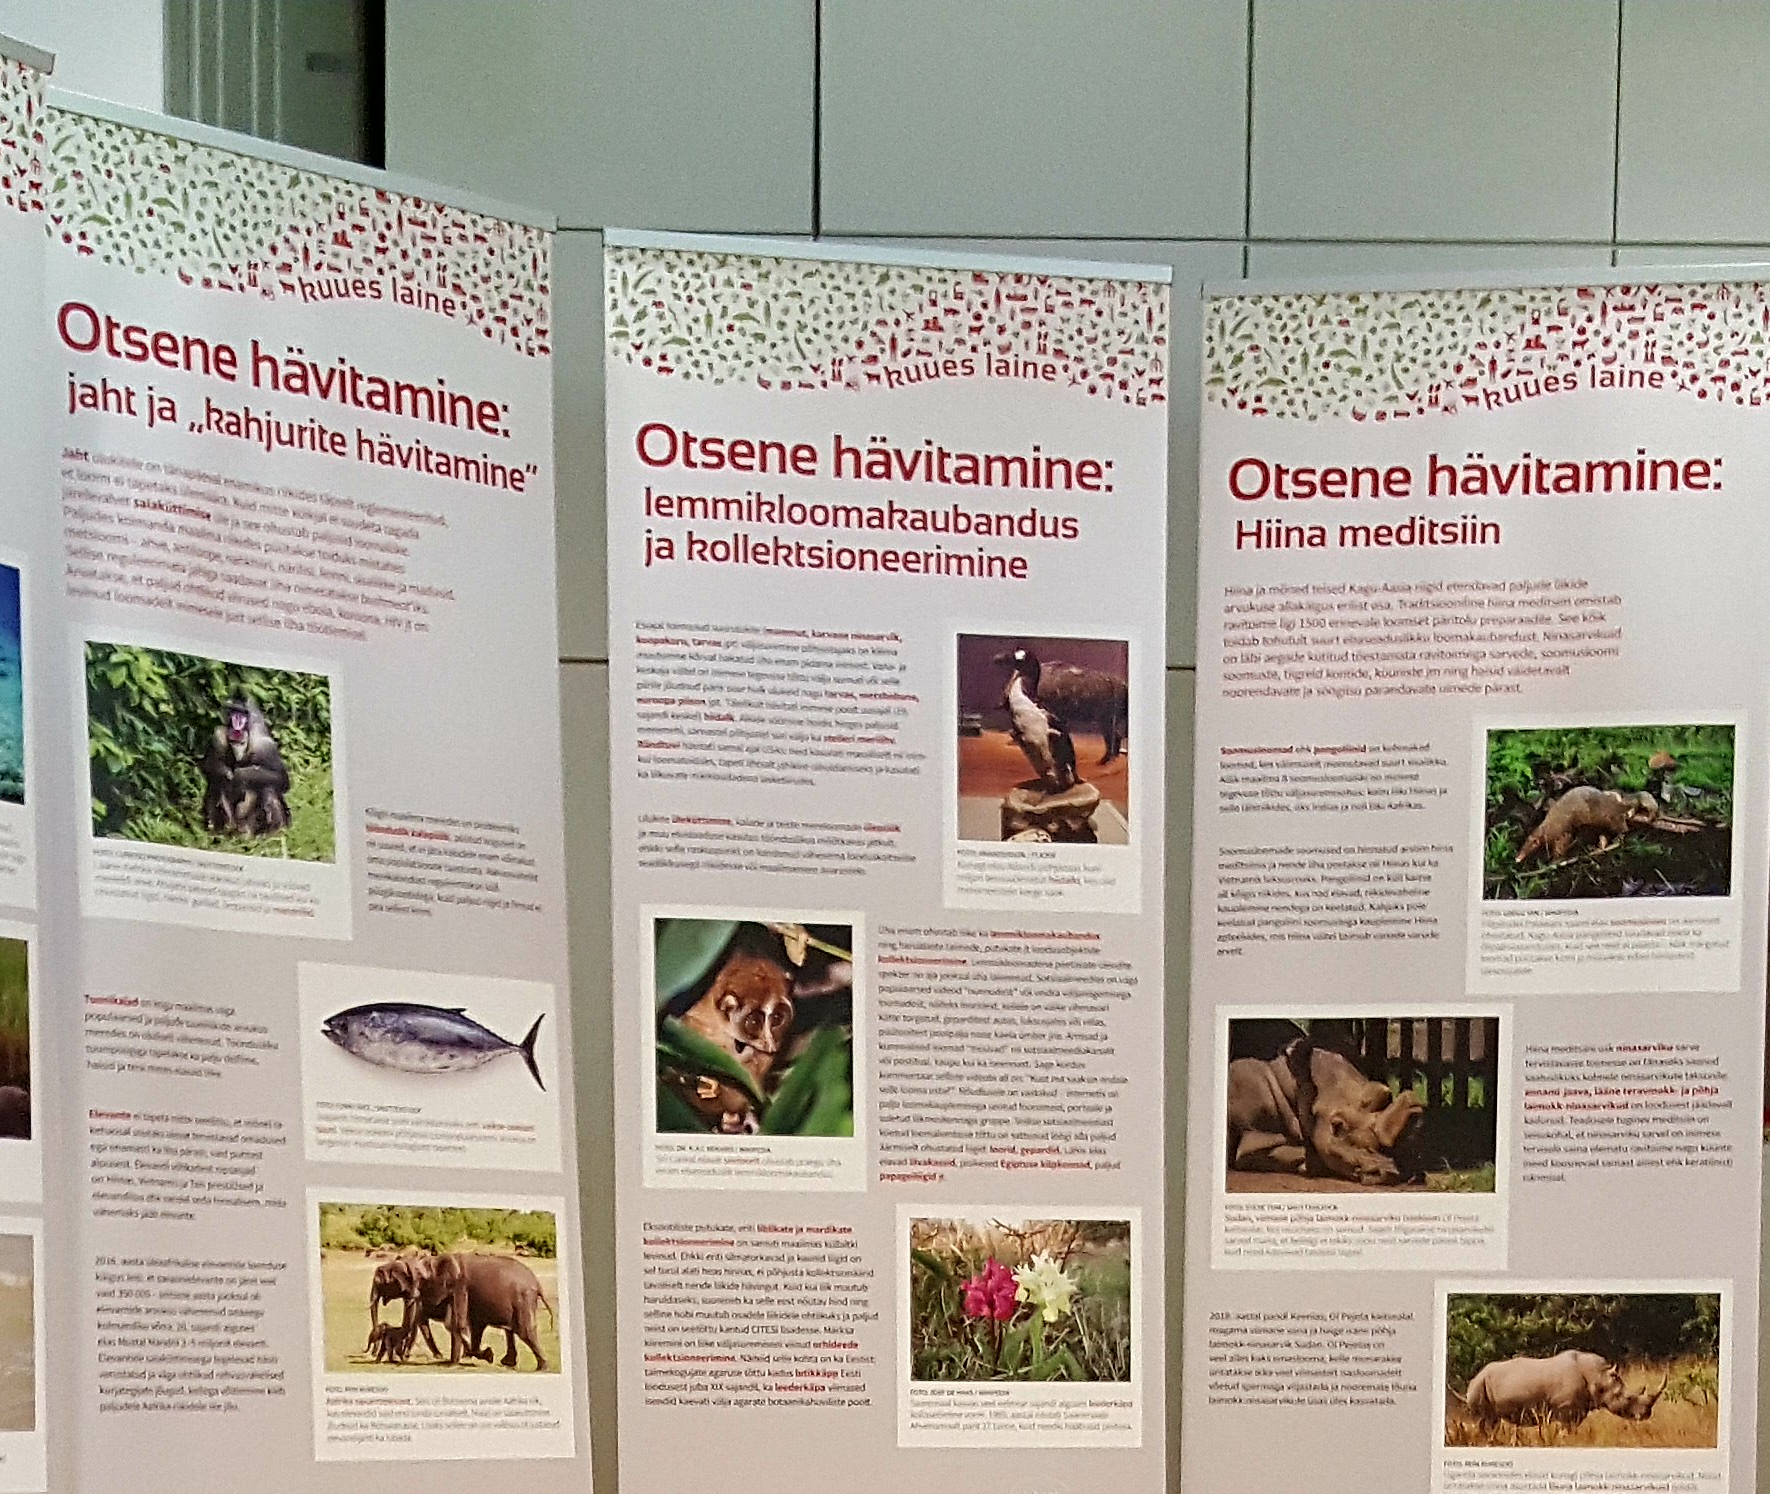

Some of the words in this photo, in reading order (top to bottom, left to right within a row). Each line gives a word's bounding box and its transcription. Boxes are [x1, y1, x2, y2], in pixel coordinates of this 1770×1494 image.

[300, 275, 384, 305] kuues
[390, 279, 457, 320] laine
[57, 301, 238, 383] Otsene
[250, 338, 511, 438] hävitamine:
[884, 354, 975, 390] kuues
[985, 351, 1057, 382] laine
[1484, 369, 1578, 410] kuues
[1588, 362, 1665, 391] laine
[68, 371, 138, 417] jaht
[147, 385, 177, 429] ja
[188, 396, 347, 457] „kahjurite
[636, 422, 818, 476] Otsene
[833, 434, 1113, 493] hävitamine:
[1228, 457, 1412, 501] Otsene
[1428, 448, 1723, 497] hävitamine:
[644, 486, 1080, 540] lemmikloomakaubandus
[1236, 518, 1327, 551] Hiina
[1339, 514, 1501, 548] meditsiin
[644, 528, 675, 568] ja
[686, 530, 1028, 579] kollektsioneerimine
